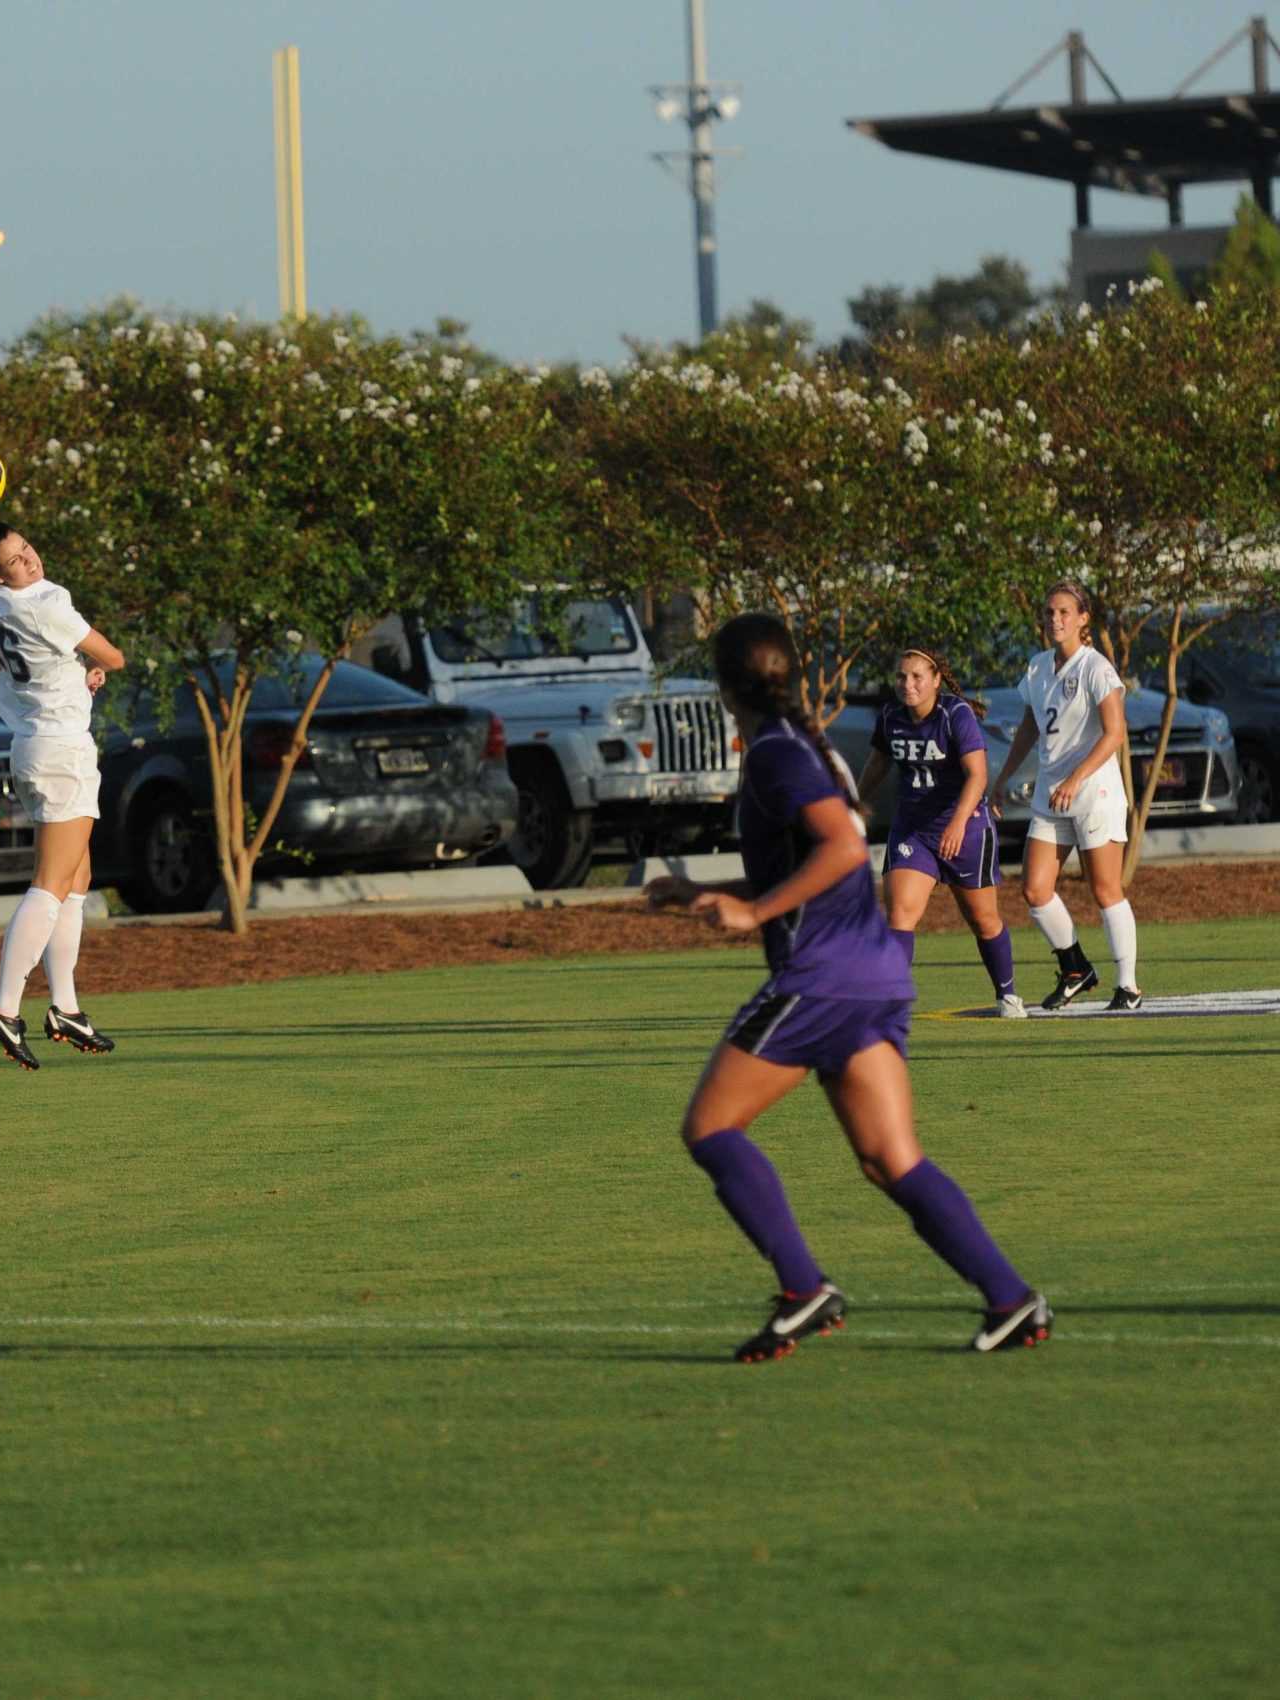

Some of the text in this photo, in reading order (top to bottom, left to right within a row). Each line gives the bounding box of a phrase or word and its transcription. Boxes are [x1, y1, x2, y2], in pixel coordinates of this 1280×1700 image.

[1046, 707, 1060, 736] 2
[891, 739, 946, 761] SFA
[911, 765, 935, 788] 11
